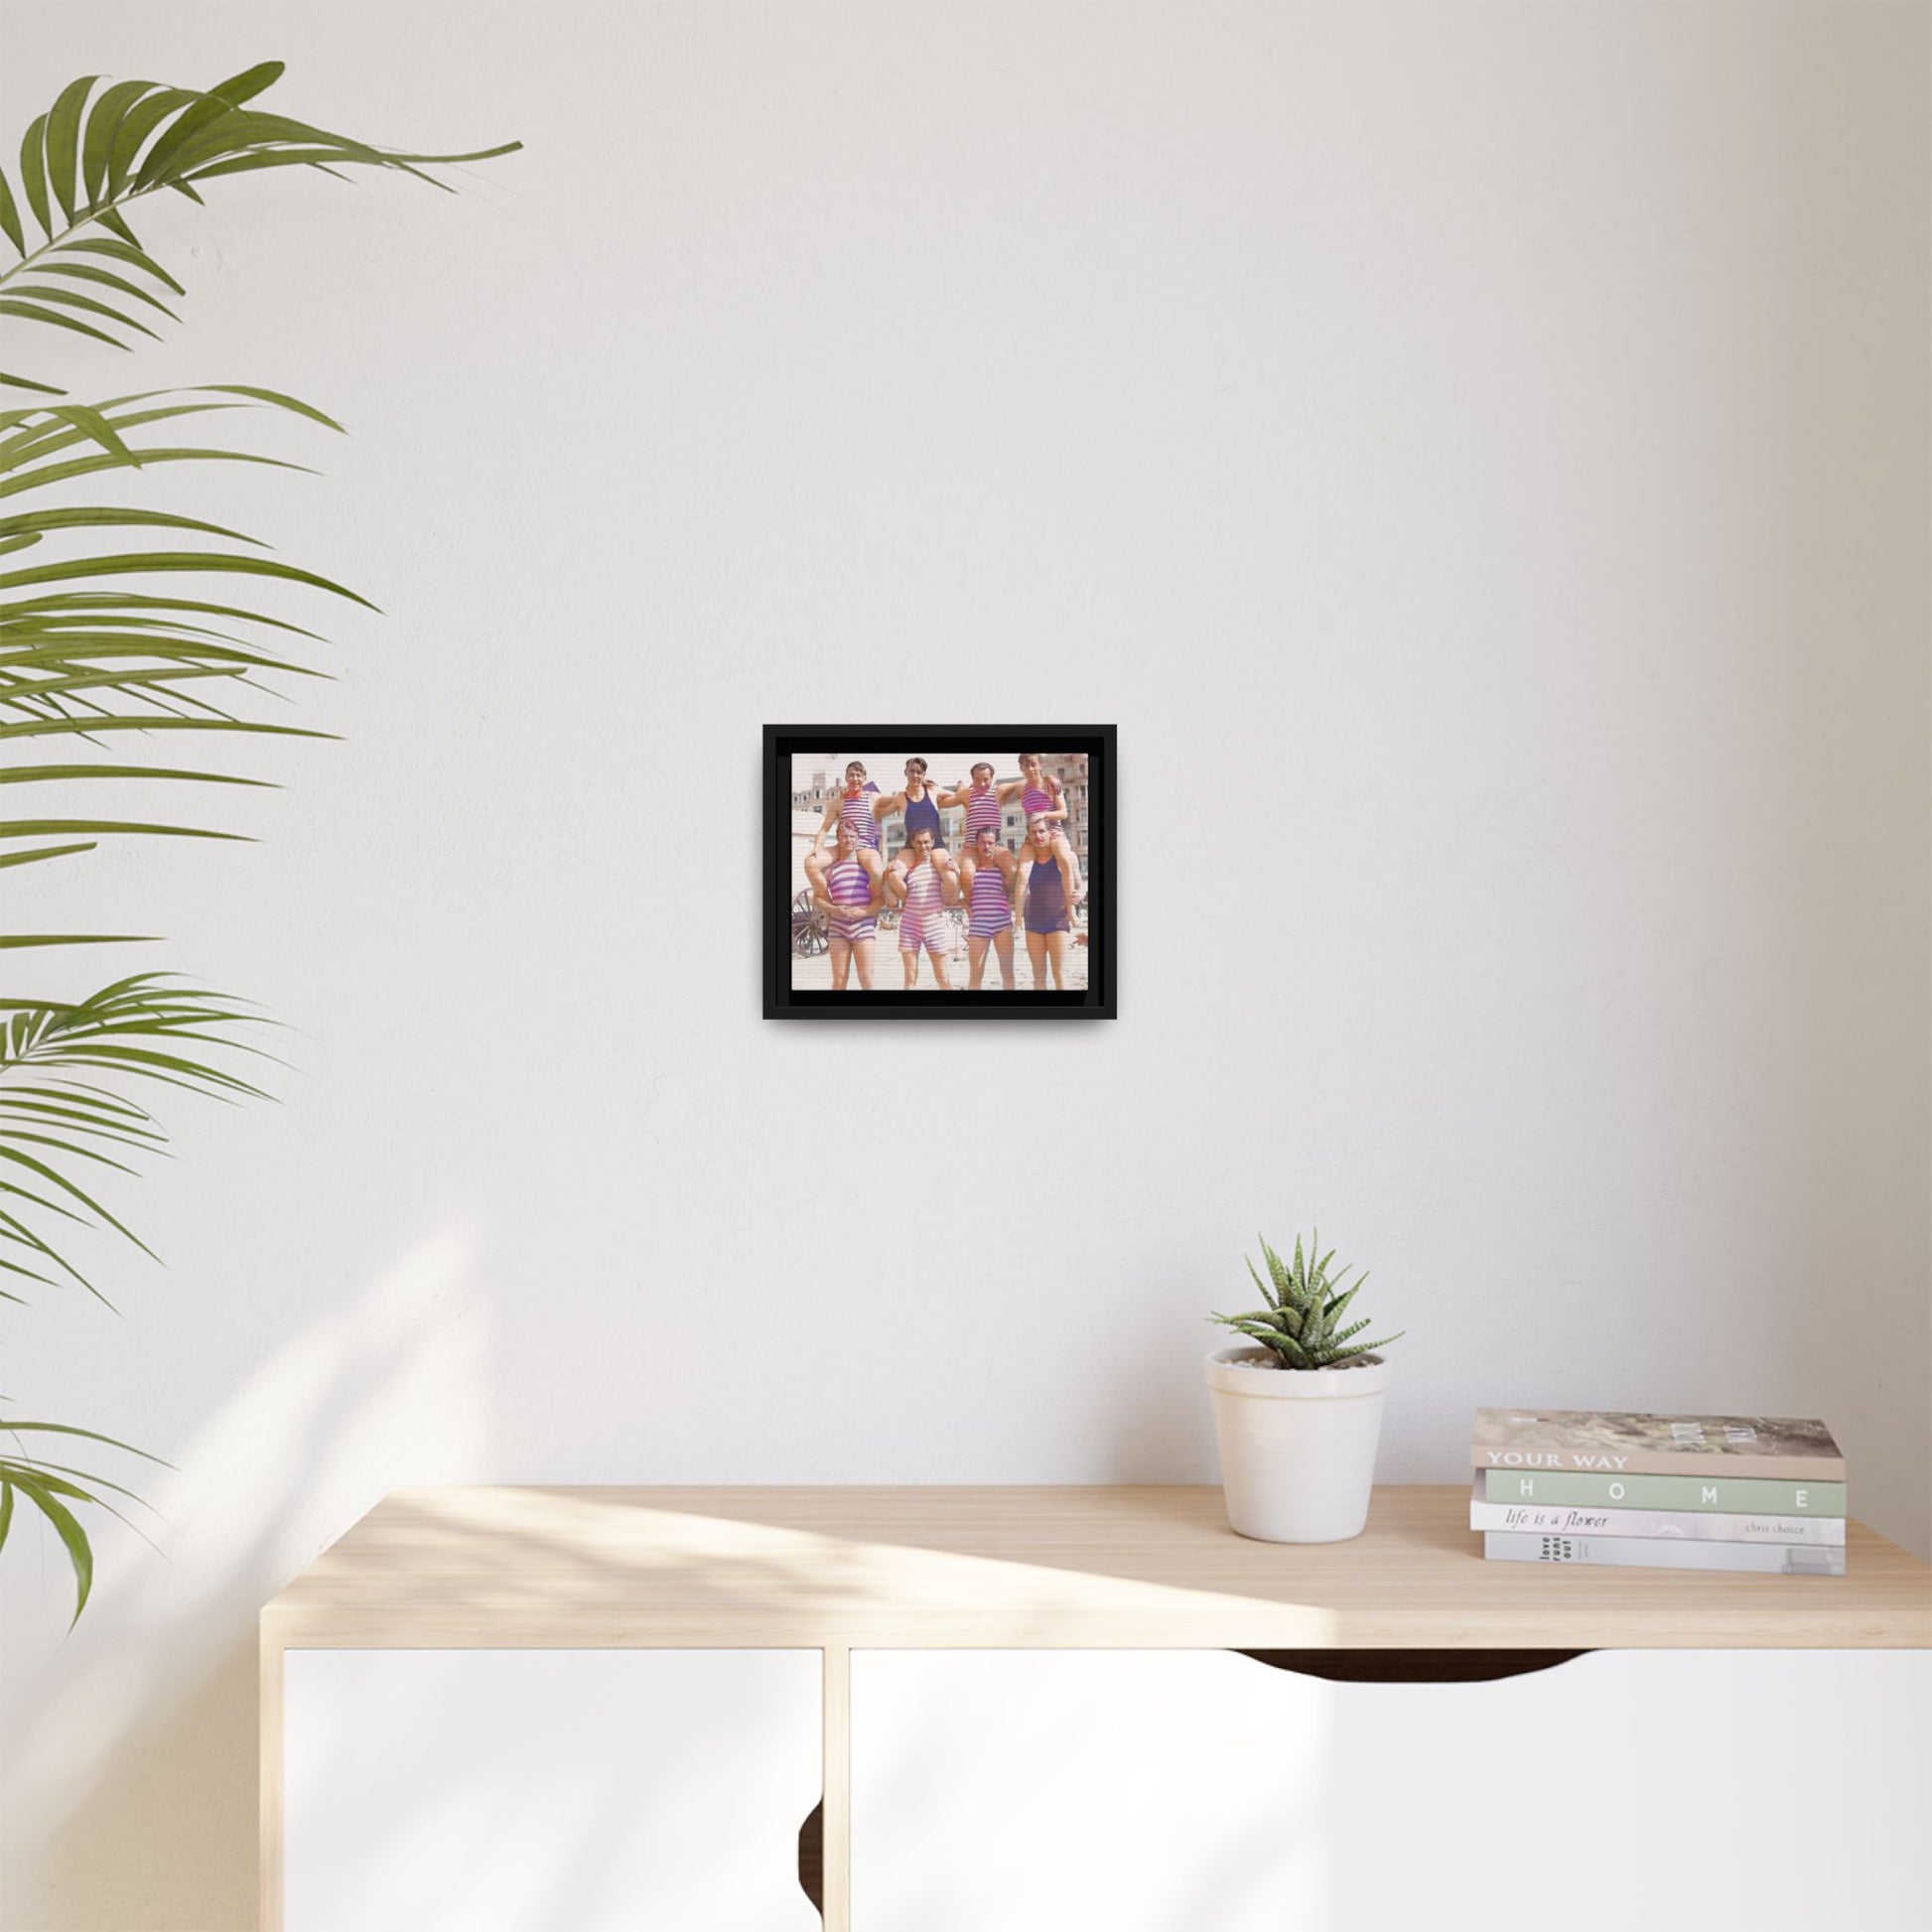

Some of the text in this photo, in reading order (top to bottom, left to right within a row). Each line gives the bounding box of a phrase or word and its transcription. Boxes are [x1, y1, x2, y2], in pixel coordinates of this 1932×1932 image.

[1487, 1451, 1629, 1469] YOUR WAY
[1505, 1508, 1609, 1531] life is a flower
[1745, 1522, 1770, 1533] chris
[1540, 1537, 1551, 1561] love
[1563, 1540, 1572, 1559] out
